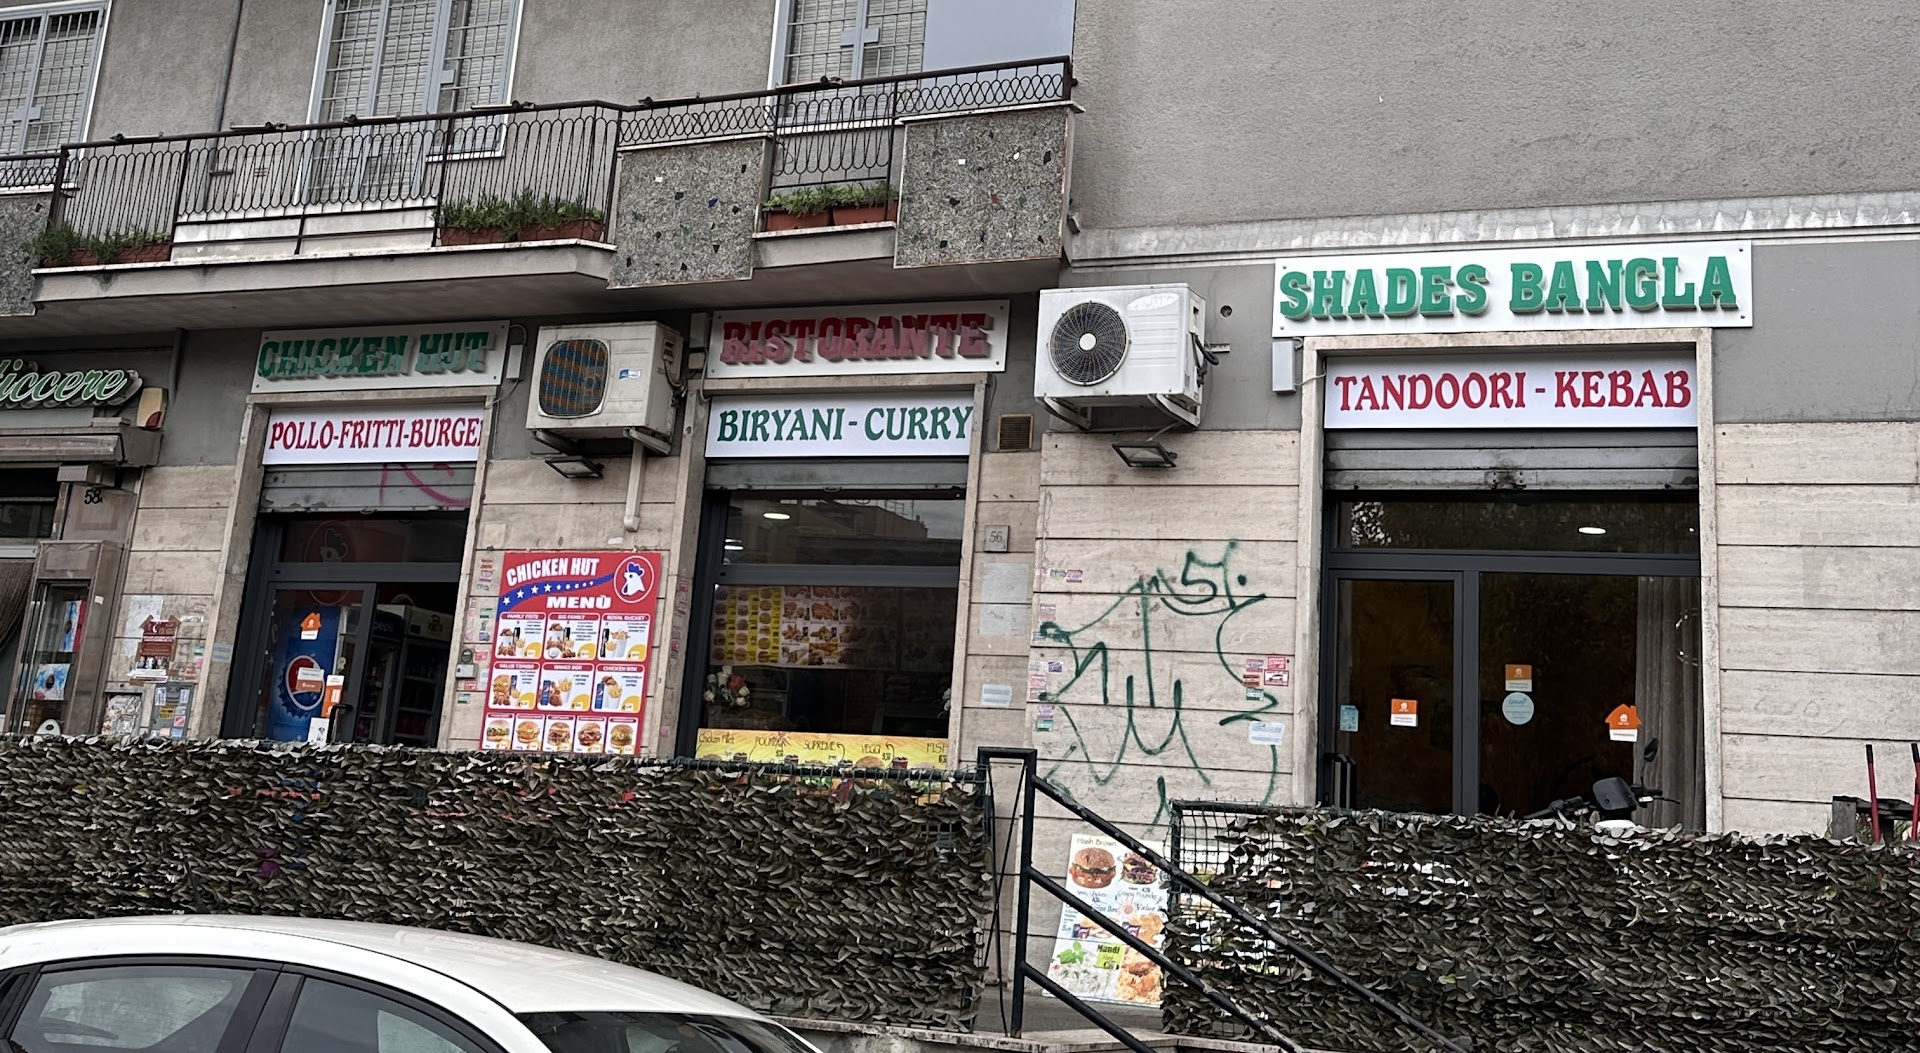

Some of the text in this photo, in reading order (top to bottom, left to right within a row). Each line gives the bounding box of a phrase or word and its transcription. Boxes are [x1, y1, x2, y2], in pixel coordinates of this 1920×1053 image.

[1279, 256, 1739, 320] SHADES BANGLA
[258, 332, 490, 378] CHICKEN HUT
[720, 313, 991, 363] RISTORANTE
[1334, 371, 1526, 412] TANDOORI
[1553, 369, 1692, 409] KEBAB
[989, 530, 1003, 544] 56
[506, 558, 568, 587] CHICKEN
[571, 557, 600, 576] HUT
[546, 594, 612, 609] MENÙ
